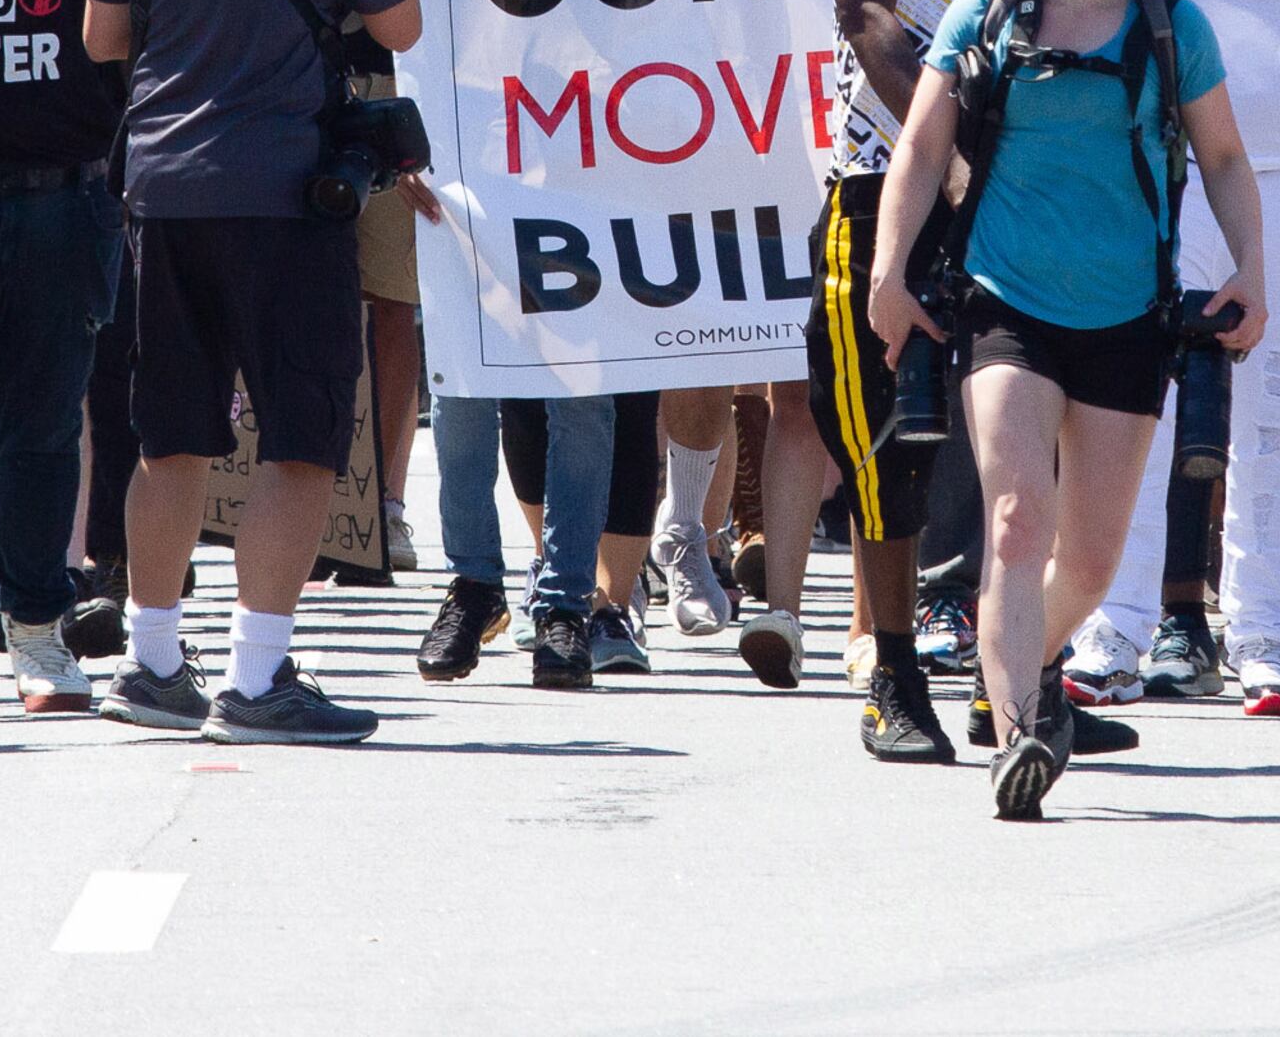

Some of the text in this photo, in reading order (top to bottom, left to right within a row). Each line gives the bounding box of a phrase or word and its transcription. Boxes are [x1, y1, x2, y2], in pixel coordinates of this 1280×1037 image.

[503, 51, 834, 174] MOVE
[512, 205, 812, 315] BUIL
[655, 323, 807, 347] COMMUNITY
